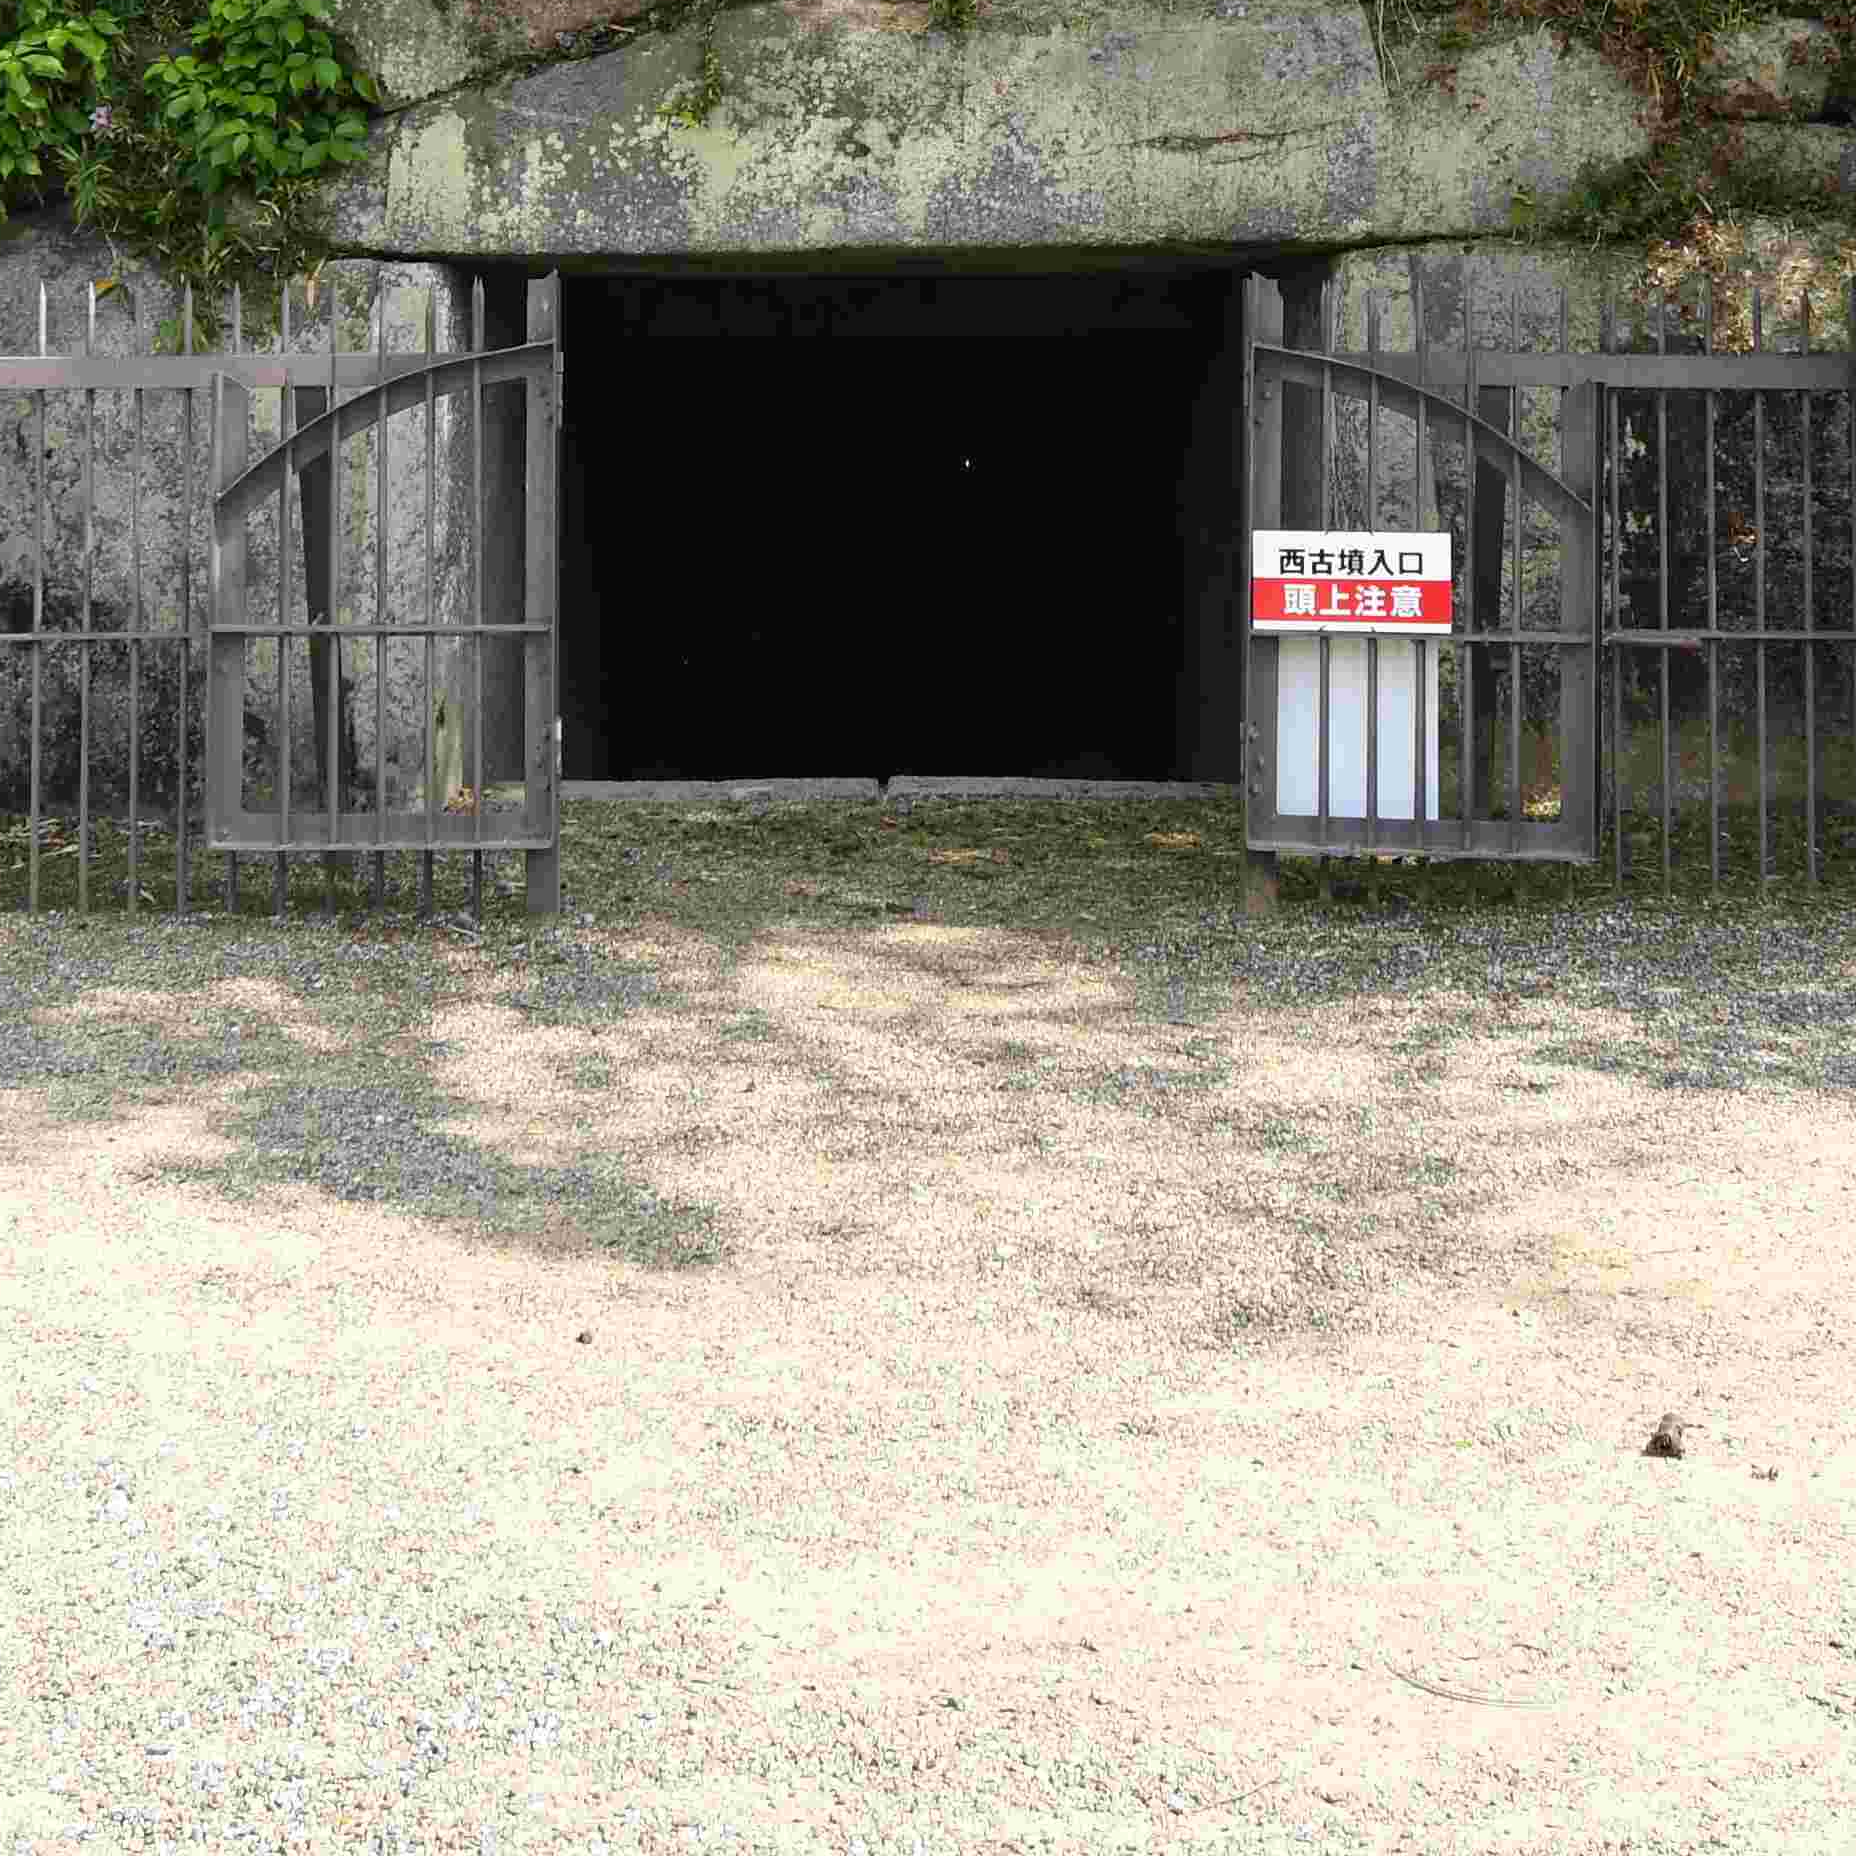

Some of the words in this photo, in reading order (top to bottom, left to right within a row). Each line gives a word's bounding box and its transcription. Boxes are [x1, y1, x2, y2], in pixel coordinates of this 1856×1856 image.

[1278, 548, 1424, 576] 西古墳入口
[1283, 584, 1423, 617] 頭上注意
